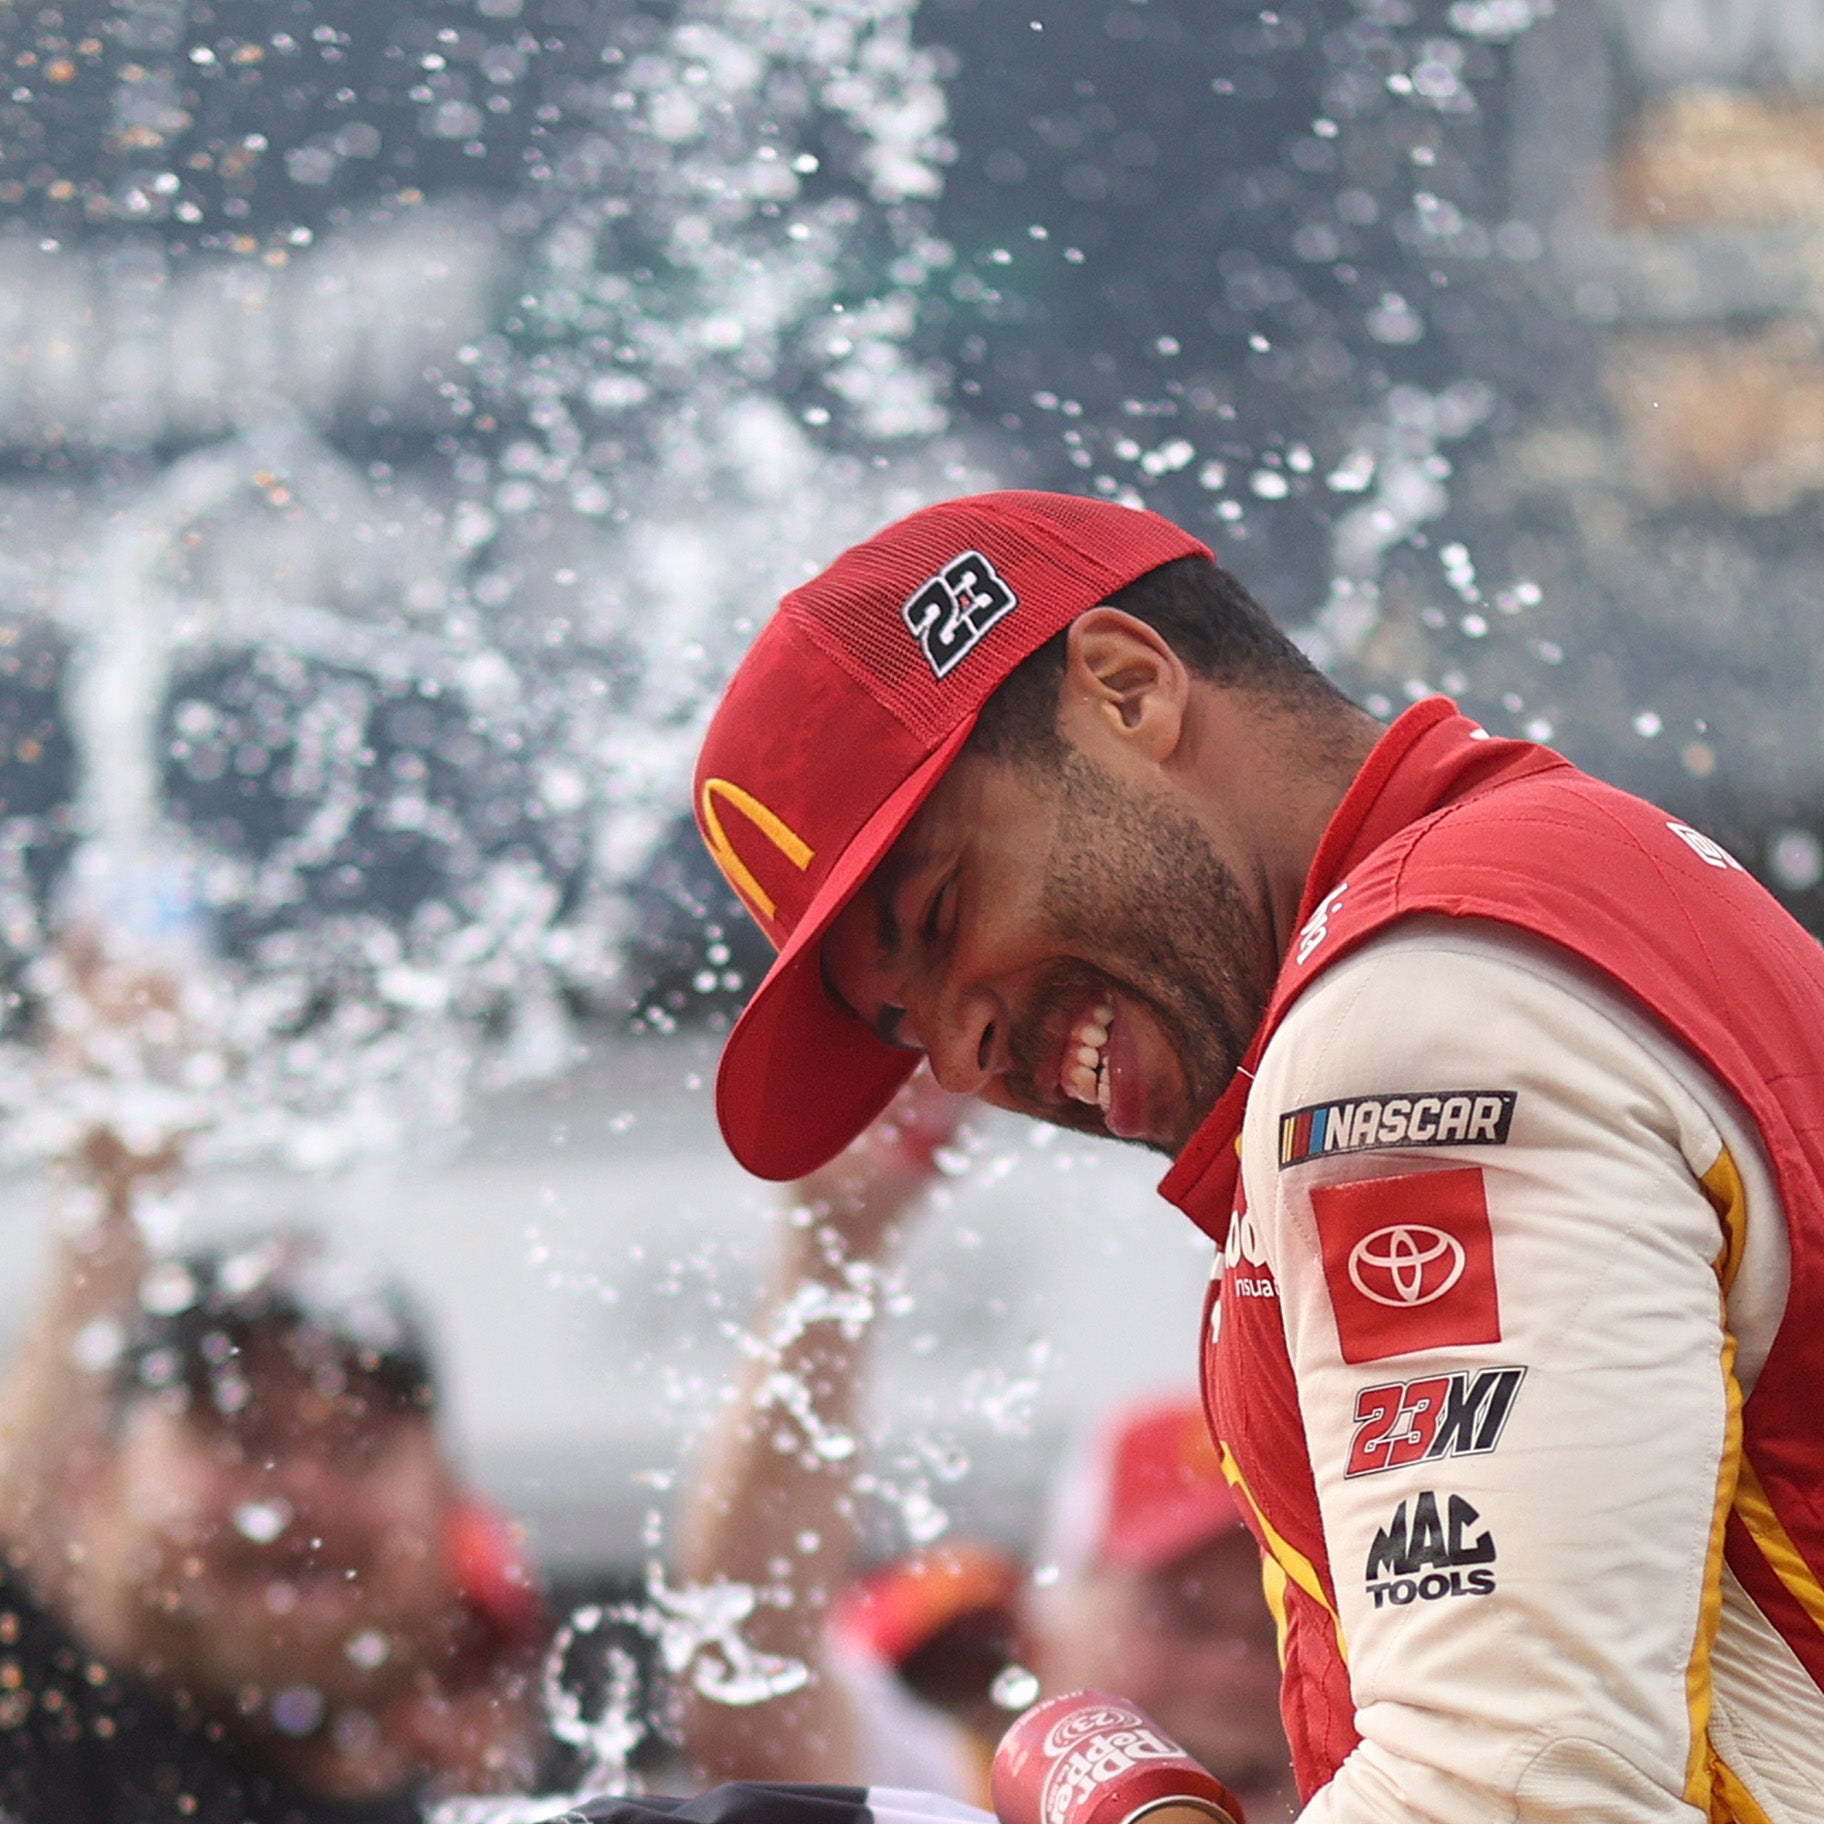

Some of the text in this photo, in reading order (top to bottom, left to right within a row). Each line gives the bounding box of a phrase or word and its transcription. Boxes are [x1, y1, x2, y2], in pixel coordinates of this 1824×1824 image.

[901, 549, 1019, 681] 23
[1324, 1096, 1504, 1151] NASCAR
[1344, 1366, 1528, 1480] 23XI
[1366, 1491, 1497, 1580] MAC
[1366, 1569, 1497, 1609] TOOLS
[1076, 1749, 1136, 1806] Dr
